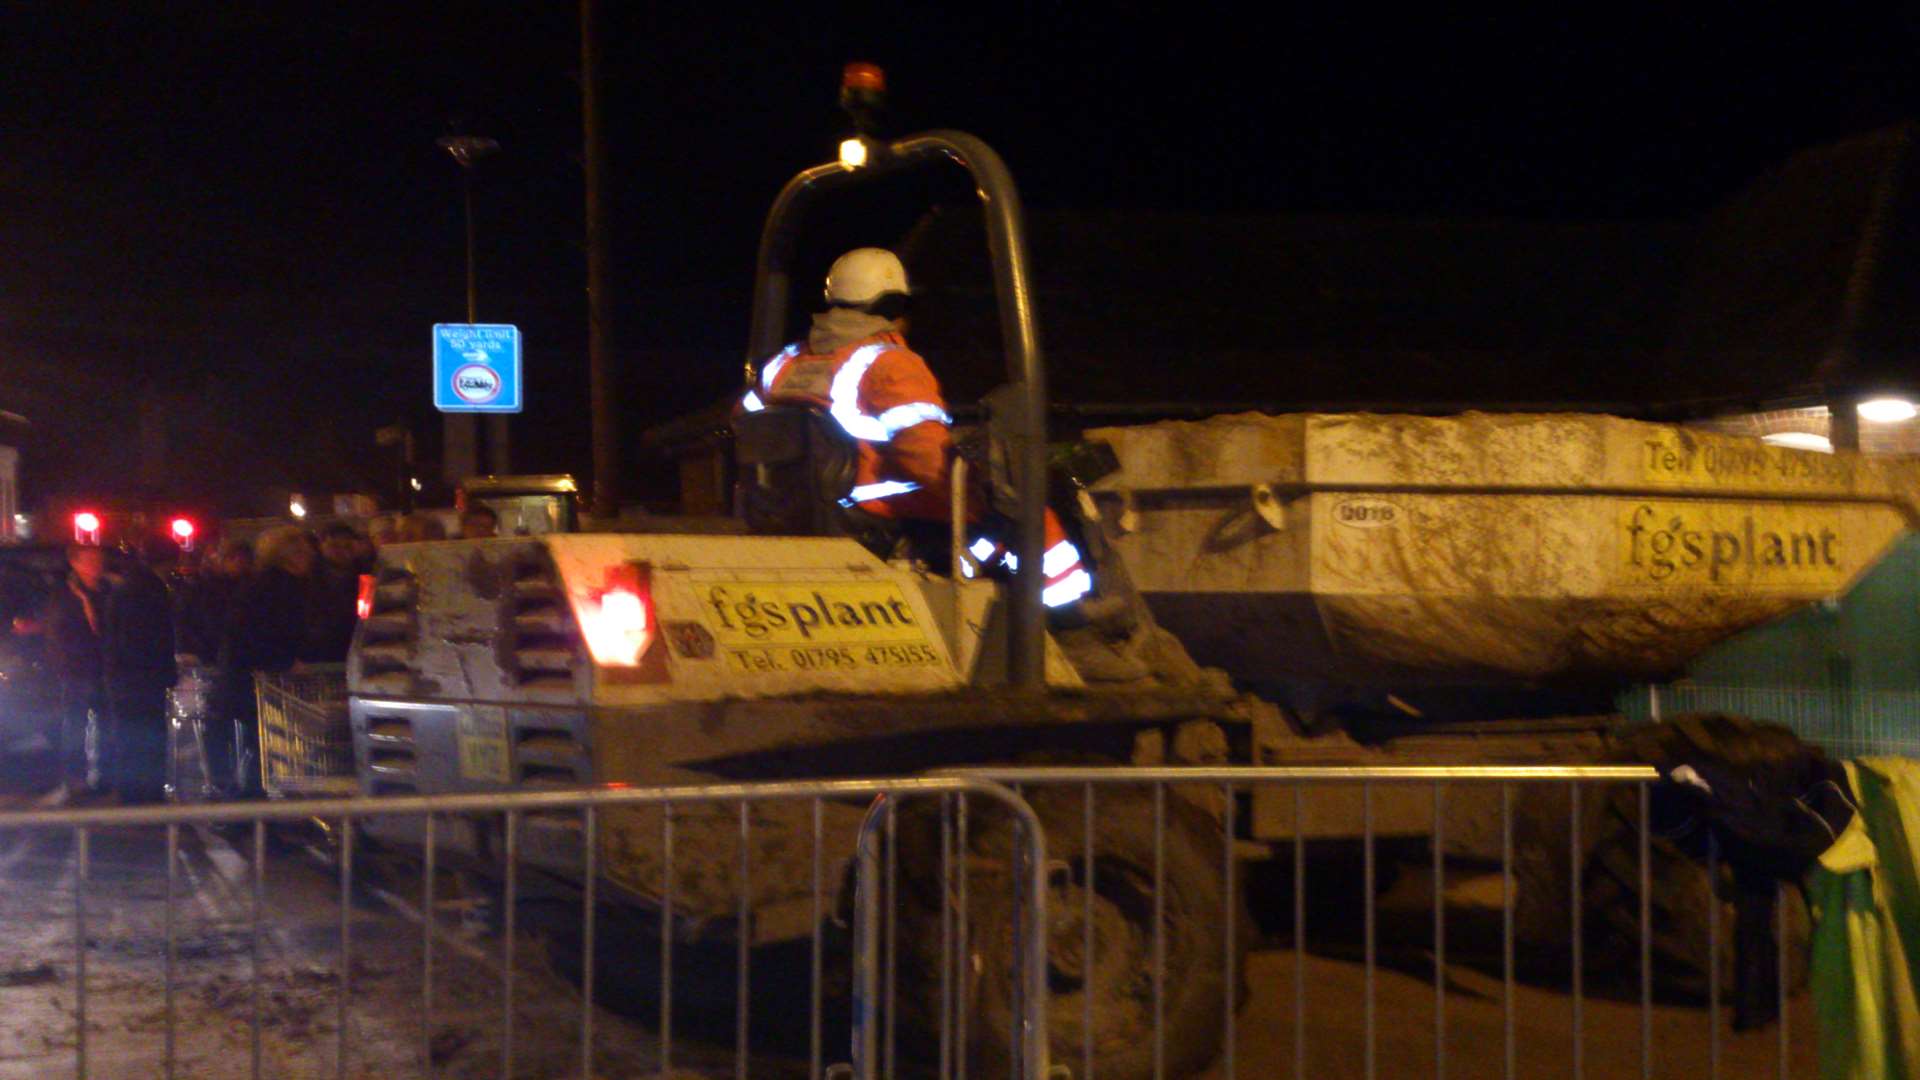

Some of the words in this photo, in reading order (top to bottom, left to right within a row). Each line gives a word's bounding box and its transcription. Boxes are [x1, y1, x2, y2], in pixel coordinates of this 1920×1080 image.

[1626, 503, 1838, 582] fgsplant
[708, 586, 914, 639] fgsplant
[791, 648, 856, 669] 01795
[865, 645, 937, 666] 475155
